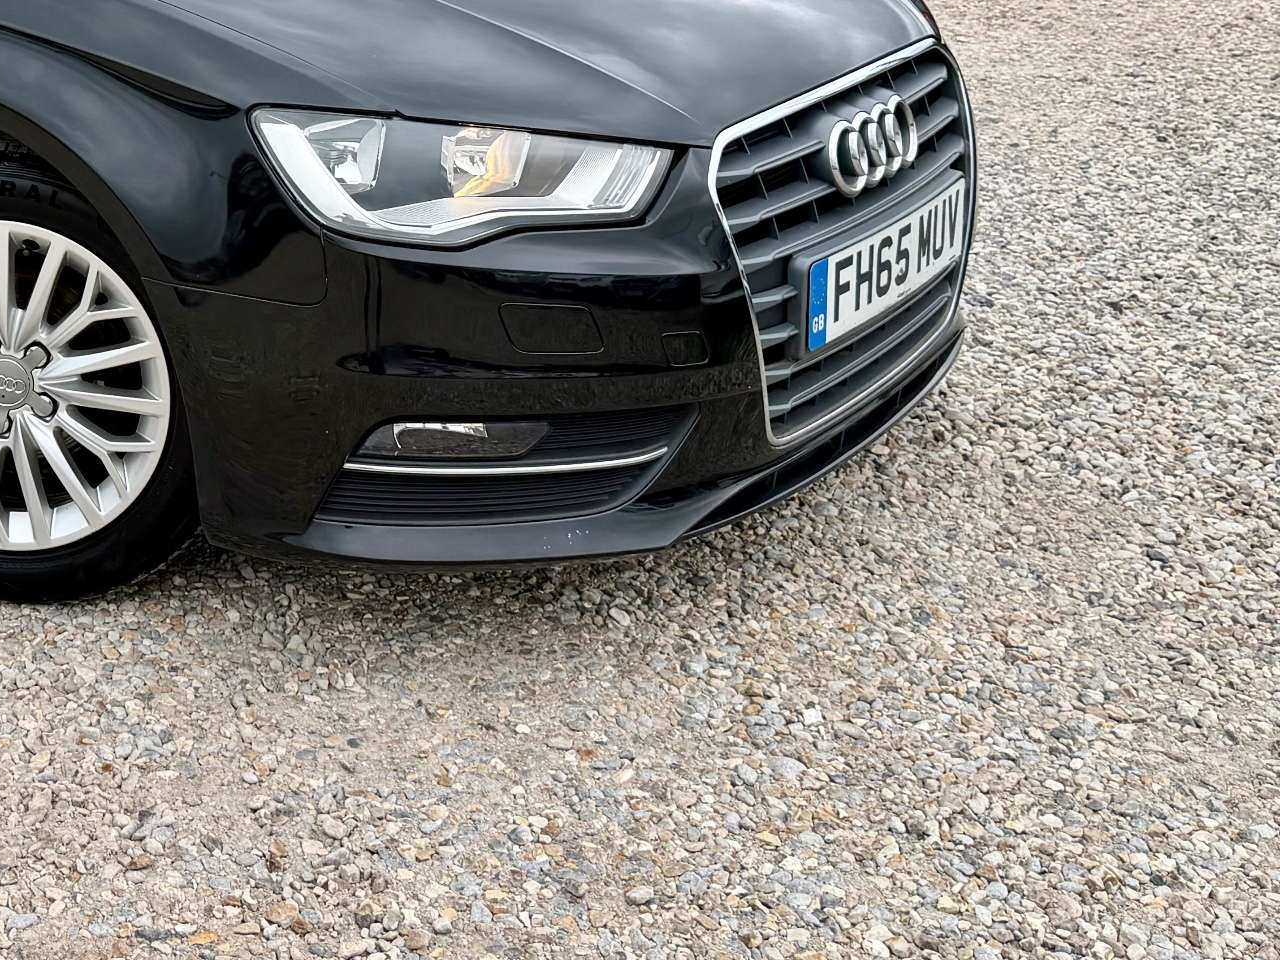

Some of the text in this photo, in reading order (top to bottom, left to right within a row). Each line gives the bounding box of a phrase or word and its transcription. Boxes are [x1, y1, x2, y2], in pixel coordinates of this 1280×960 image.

[833, 189, 960, 324] FH65 MUV
[812, 313, 825, 334] GB
